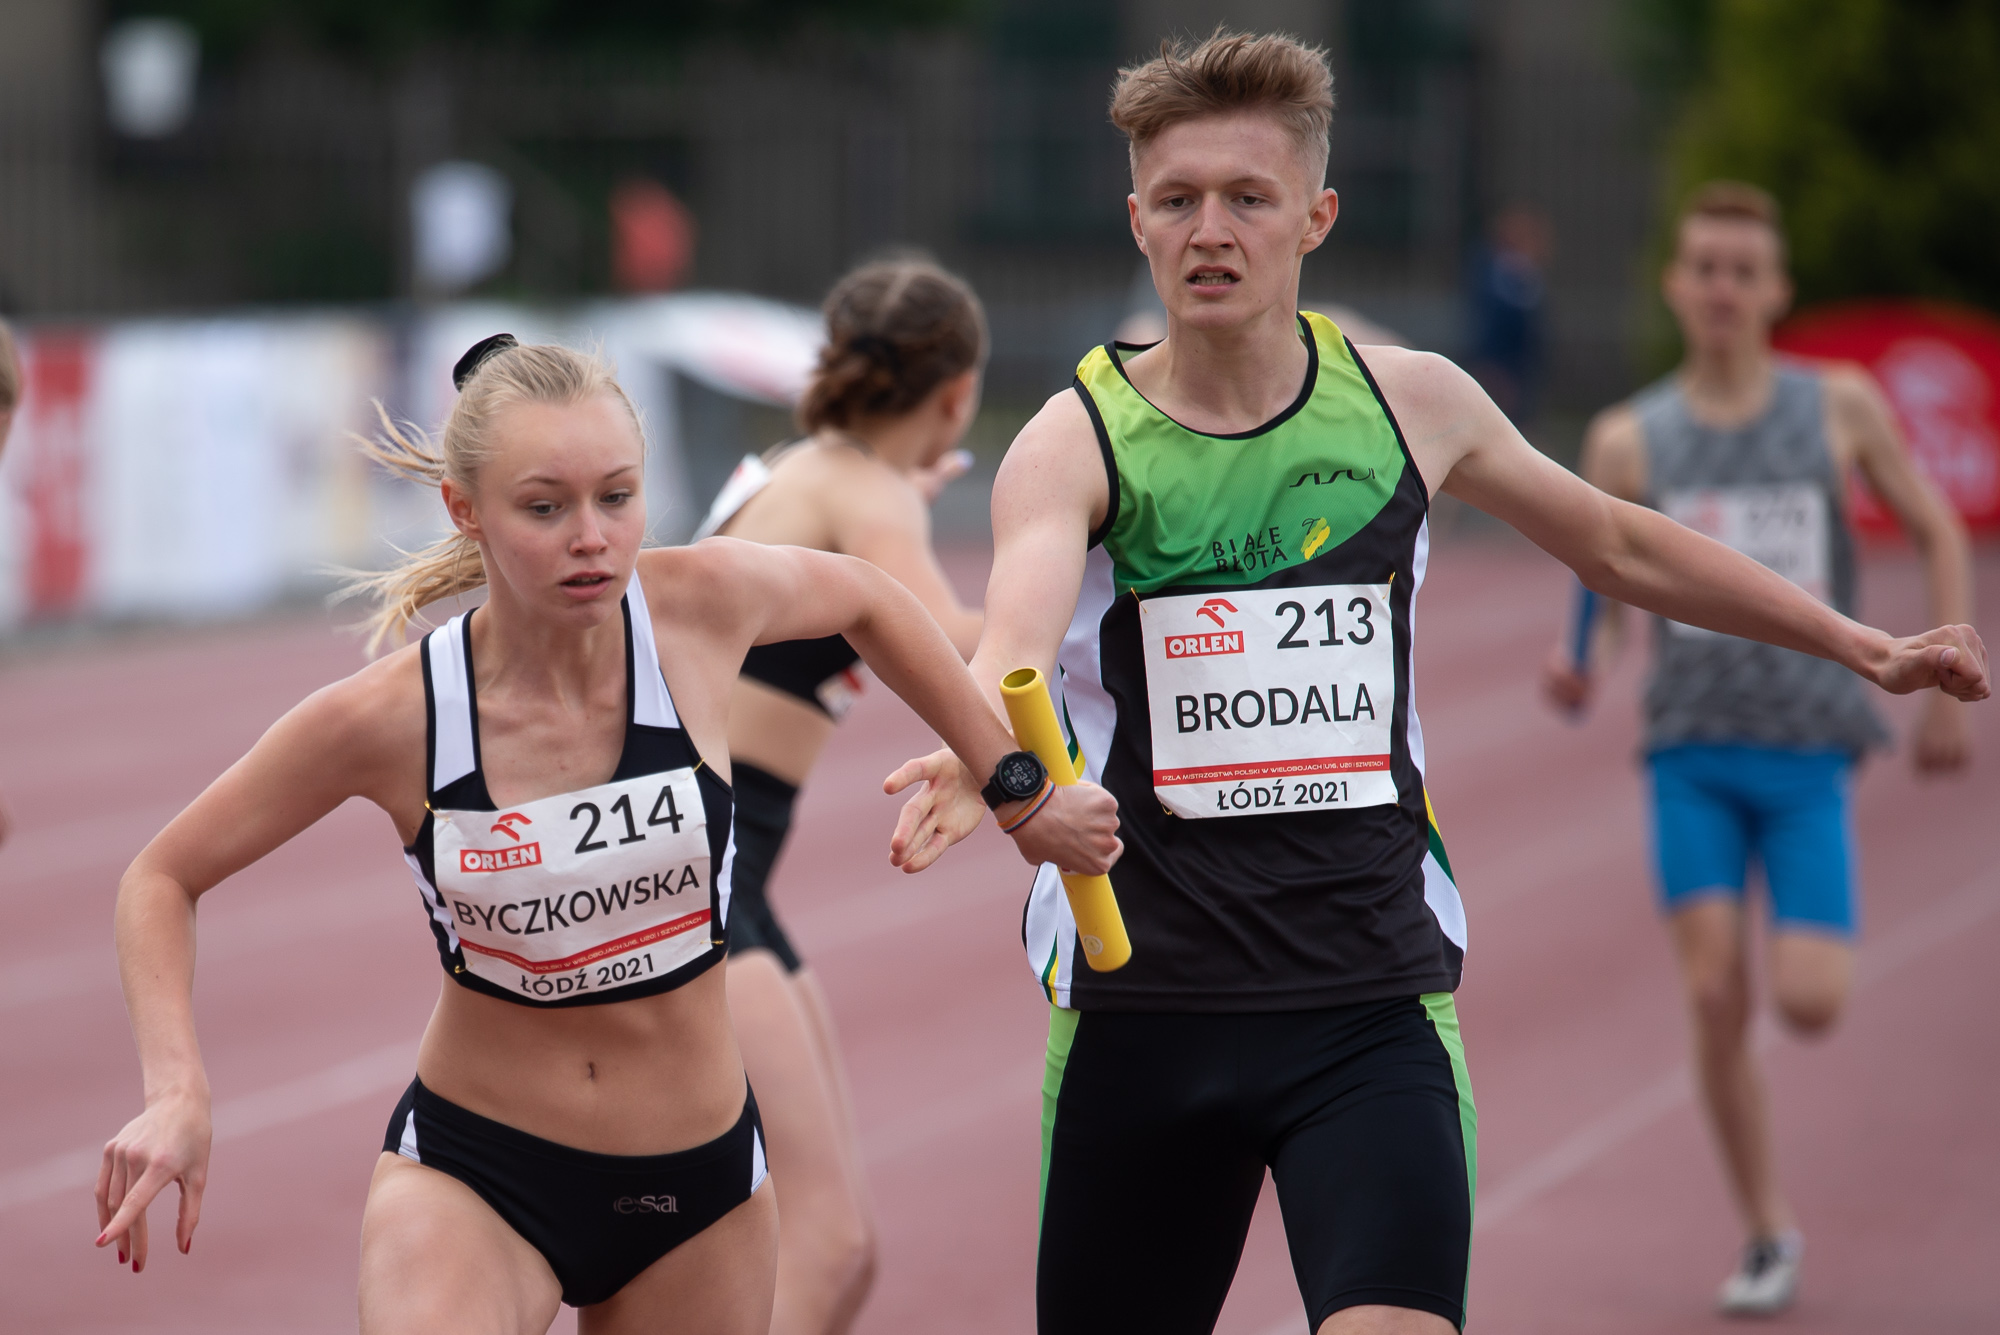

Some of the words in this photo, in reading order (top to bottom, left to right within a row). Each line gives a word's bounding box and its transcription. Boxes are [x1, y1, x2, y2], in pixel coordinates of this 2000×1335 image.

[1215, 546, 1288, 573] BŁOTA
[1275, 597, 1375, 650] 213
[1169, 634, 1239, 655] ORLEN
[1175, 683, 1376, 734] BRODALA
[1012, 762, 1032, 786] 12:34
[1182, 769, 1233, 780] MISTRZOSTWA
[1234, 768, 1260, 776] POLSKI
[1270, 763, 1322, 774] WIELOBOJACH
[1217, 778, 1286, 811] ŁÓDŹ
[1294, 780, 1348, 805] 2021
[569, 785, 684, 855] 214
[463, 846, 537, 870] ORLEN
[453, 864, 700, 936] BYCZKOWSKA
[520, 968, 589, 996] ŁÓDŹ
[597, 953, 654, 986] 2021
